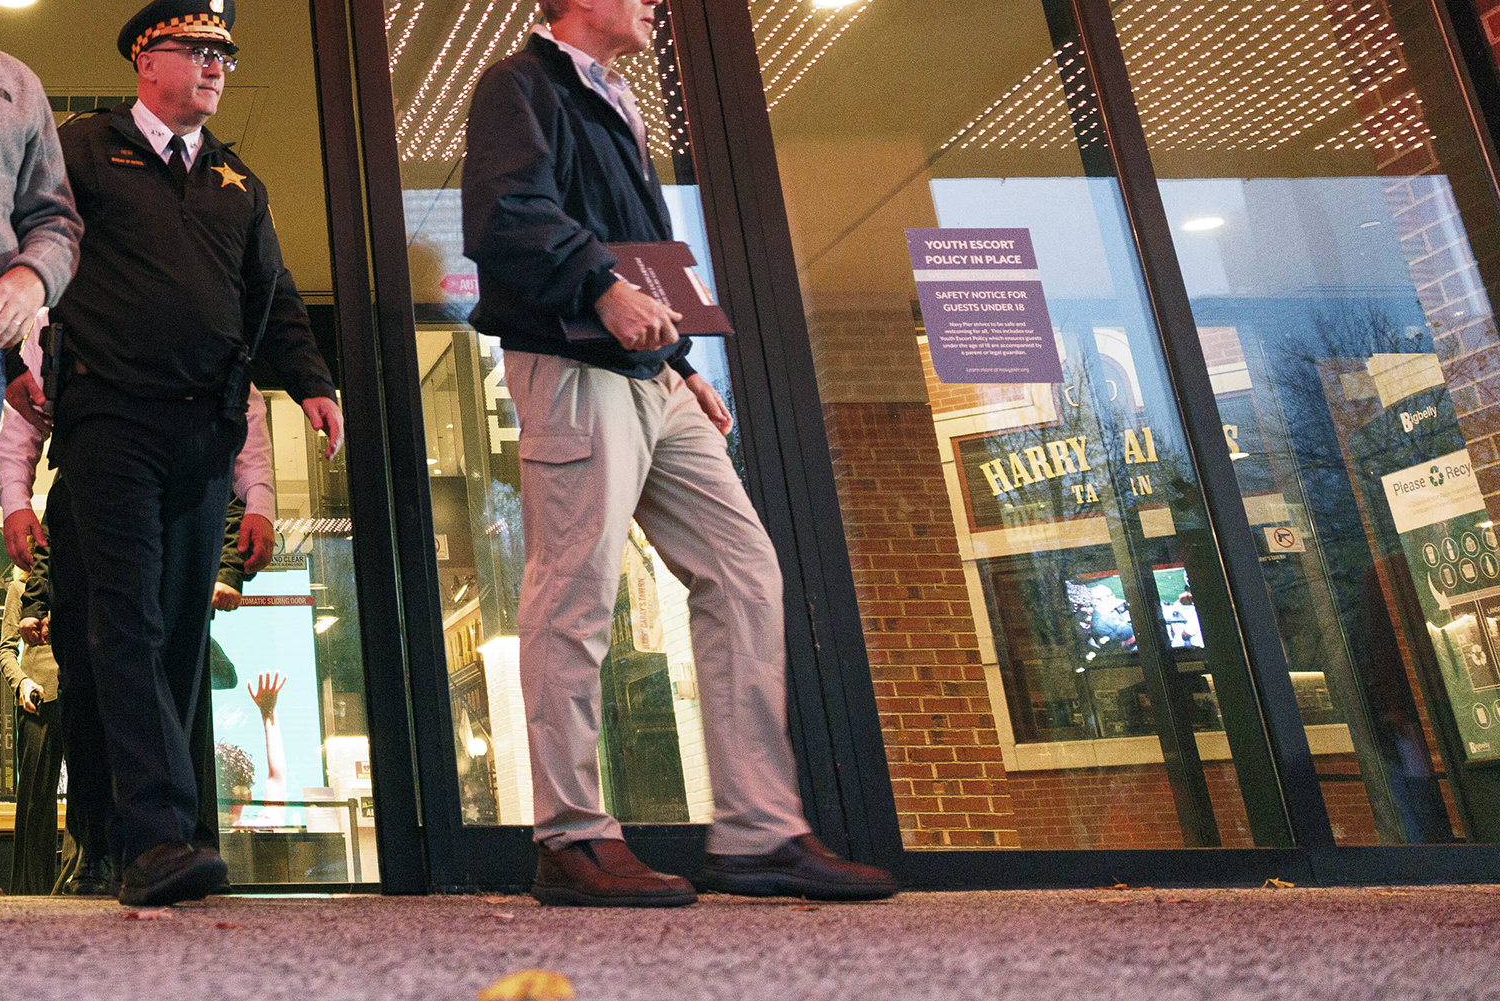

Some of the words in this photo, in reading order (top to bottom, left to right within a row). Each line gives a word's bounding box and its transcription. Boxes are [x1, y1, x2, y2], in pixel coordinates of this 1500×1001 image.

[925, 240, 968, 249] YOUTH
[970, 240, 1014, 249] ESCORT
[925, 255, 967, 264] POLICY
[970, 255, 983, 264] IN
[985, 255, 1022, 264] PLACE
[935, 291, 970, 299] SAFETY
[971, 291, 1005, 299] NOTICE
[1007, 291, 1027, 299] FOR
[1400, 406, 1437, 433] Bigbelly
[980, 436, 1091, 496] HARRY
[1393, 477, 1426, 496] Please
[1445, 463, 1471, 479] Recy
[638, 578, 646, 601] TAVERN
